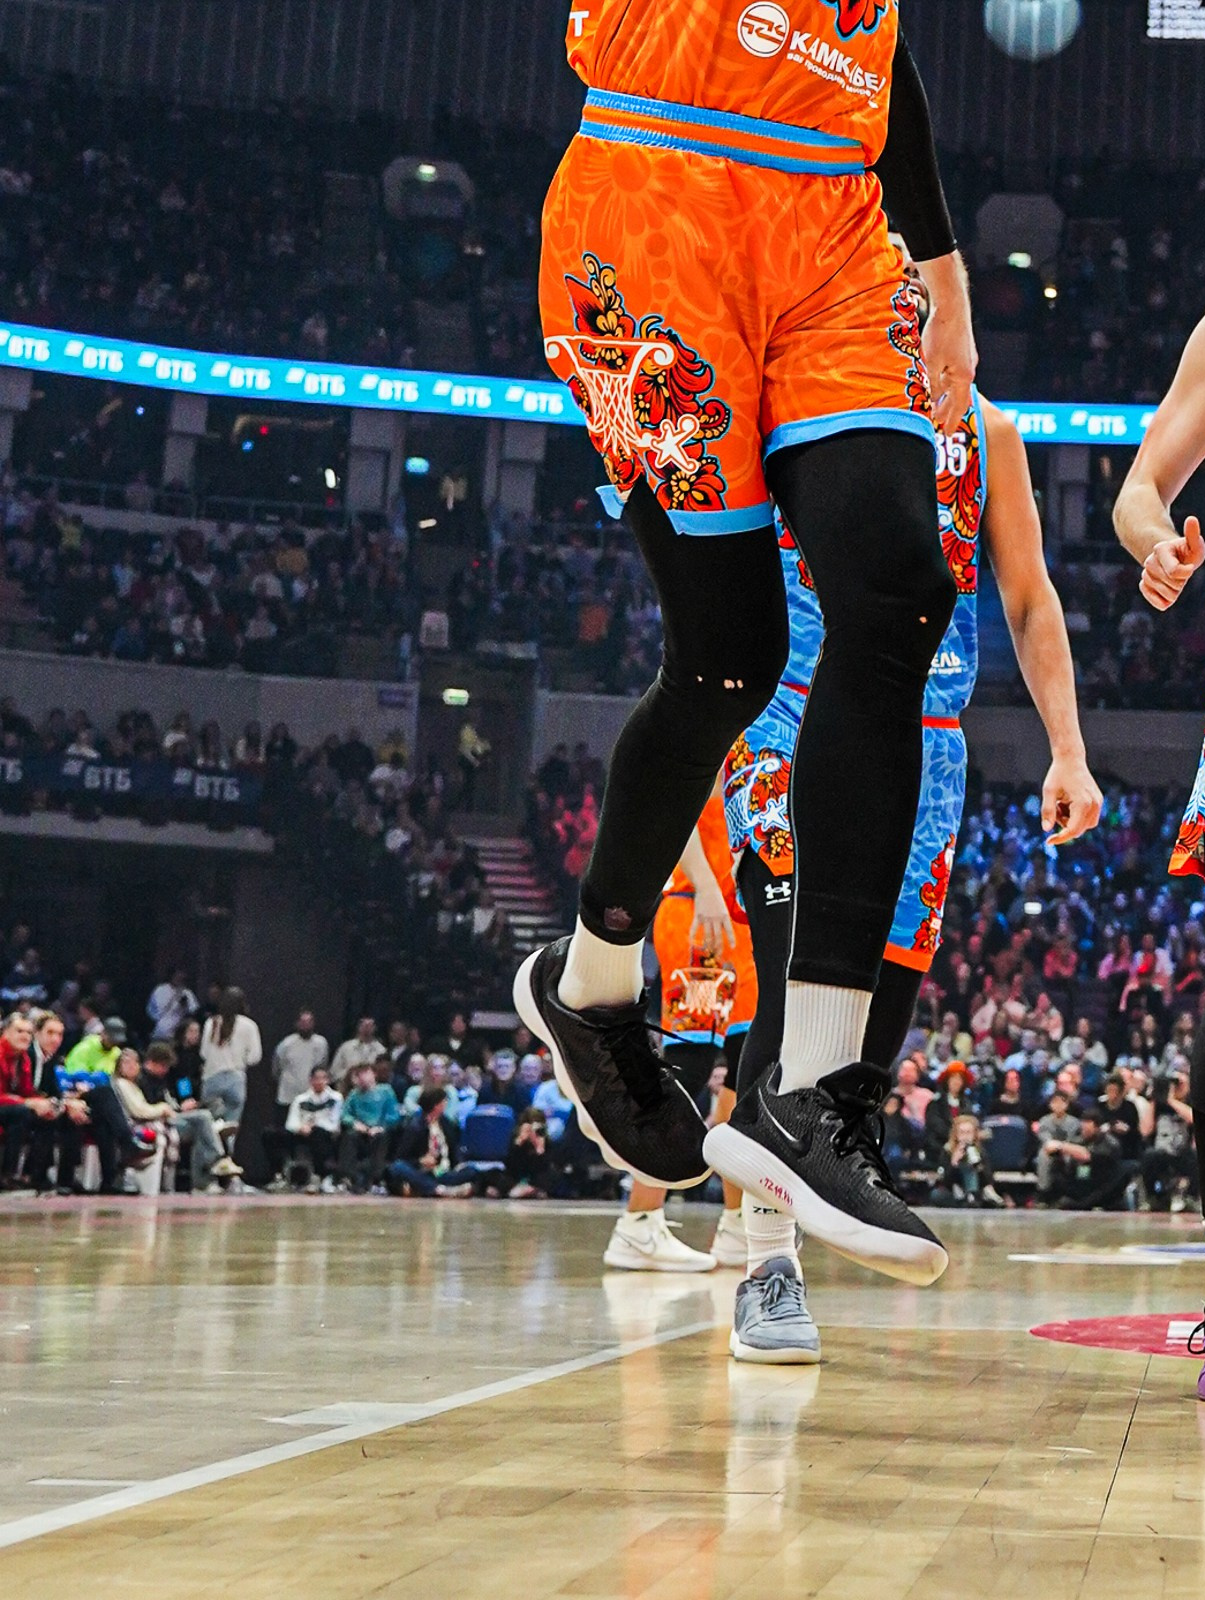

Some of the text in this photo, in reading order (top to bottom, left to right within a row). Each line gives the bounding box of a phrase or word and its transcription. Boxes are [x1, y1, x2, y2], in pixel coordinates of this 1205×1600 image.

[8, 336, 563, 413] ВТБ ВТБ ВТБ ВТБ ВТБ ВТБ ВТБ ВТБ
[1088, 416, 1126, 435] ВТБ
